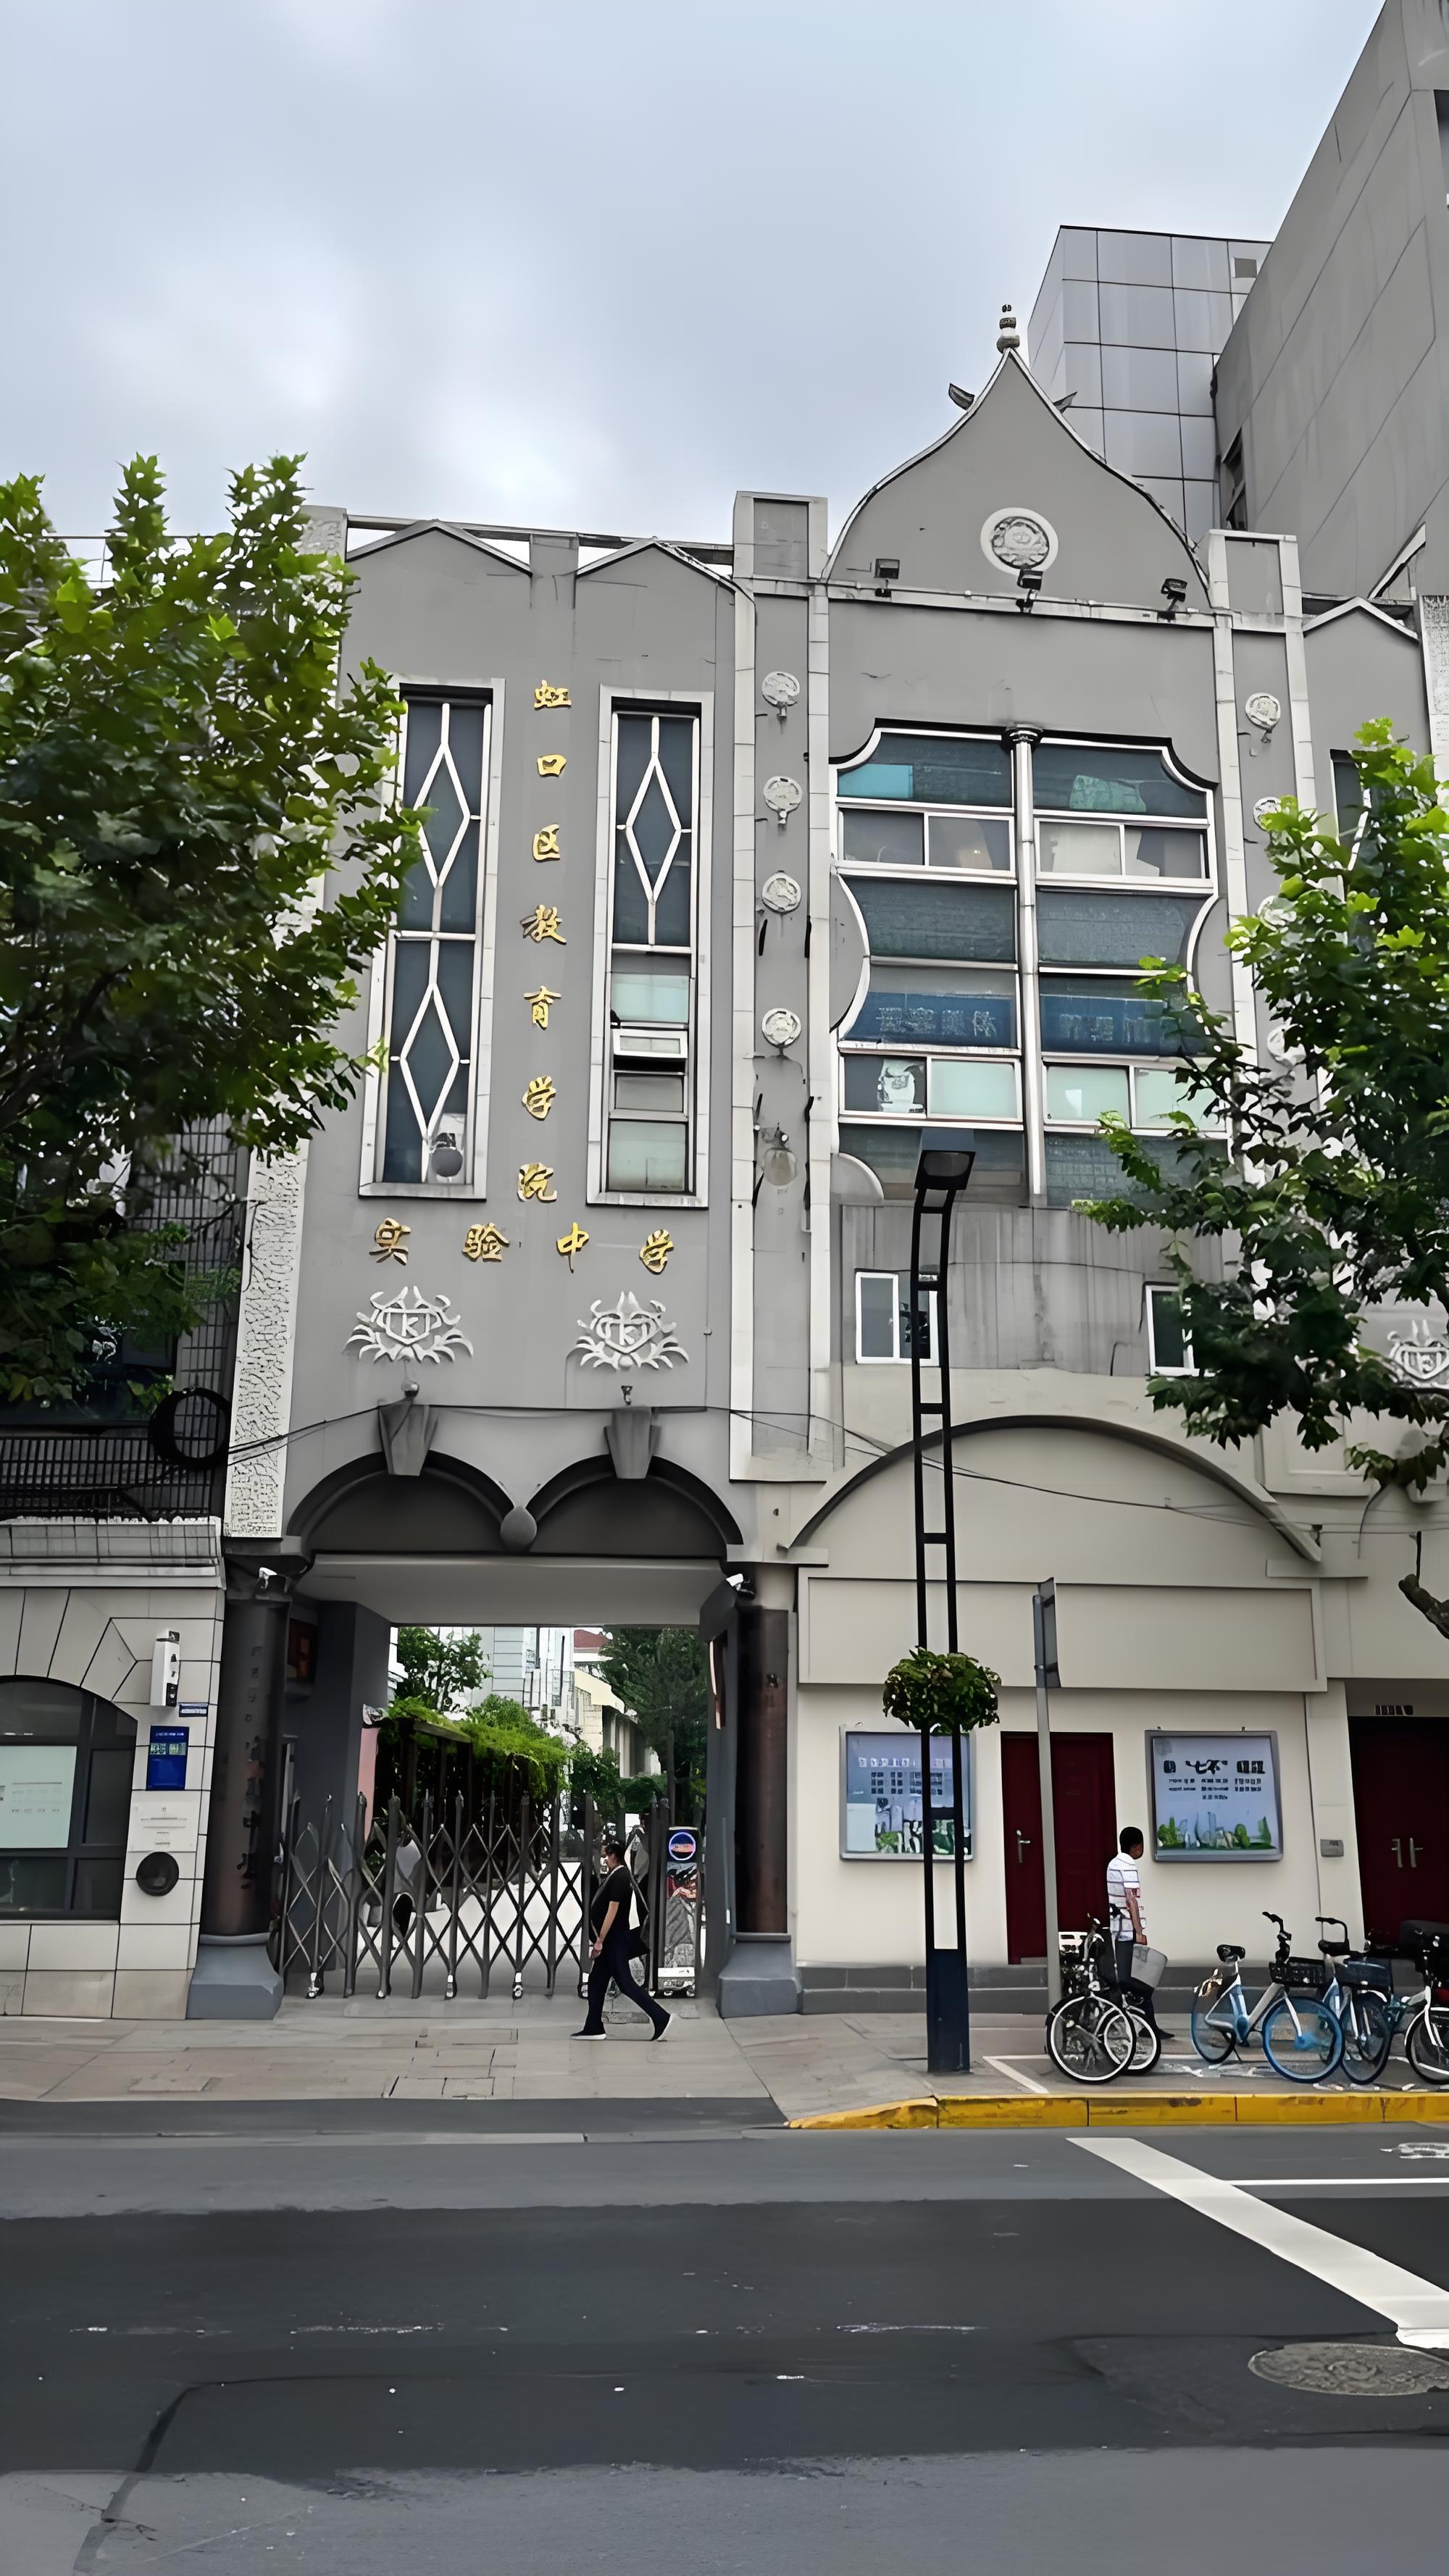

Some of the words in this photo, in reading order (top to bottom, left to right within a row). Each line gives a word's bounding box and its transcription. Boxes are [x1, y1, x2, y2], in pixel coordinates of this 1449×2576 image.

[518, 679, 572, 1203] 虹口区教育学院
[369, 1218, 675, 1275] 实验中学
